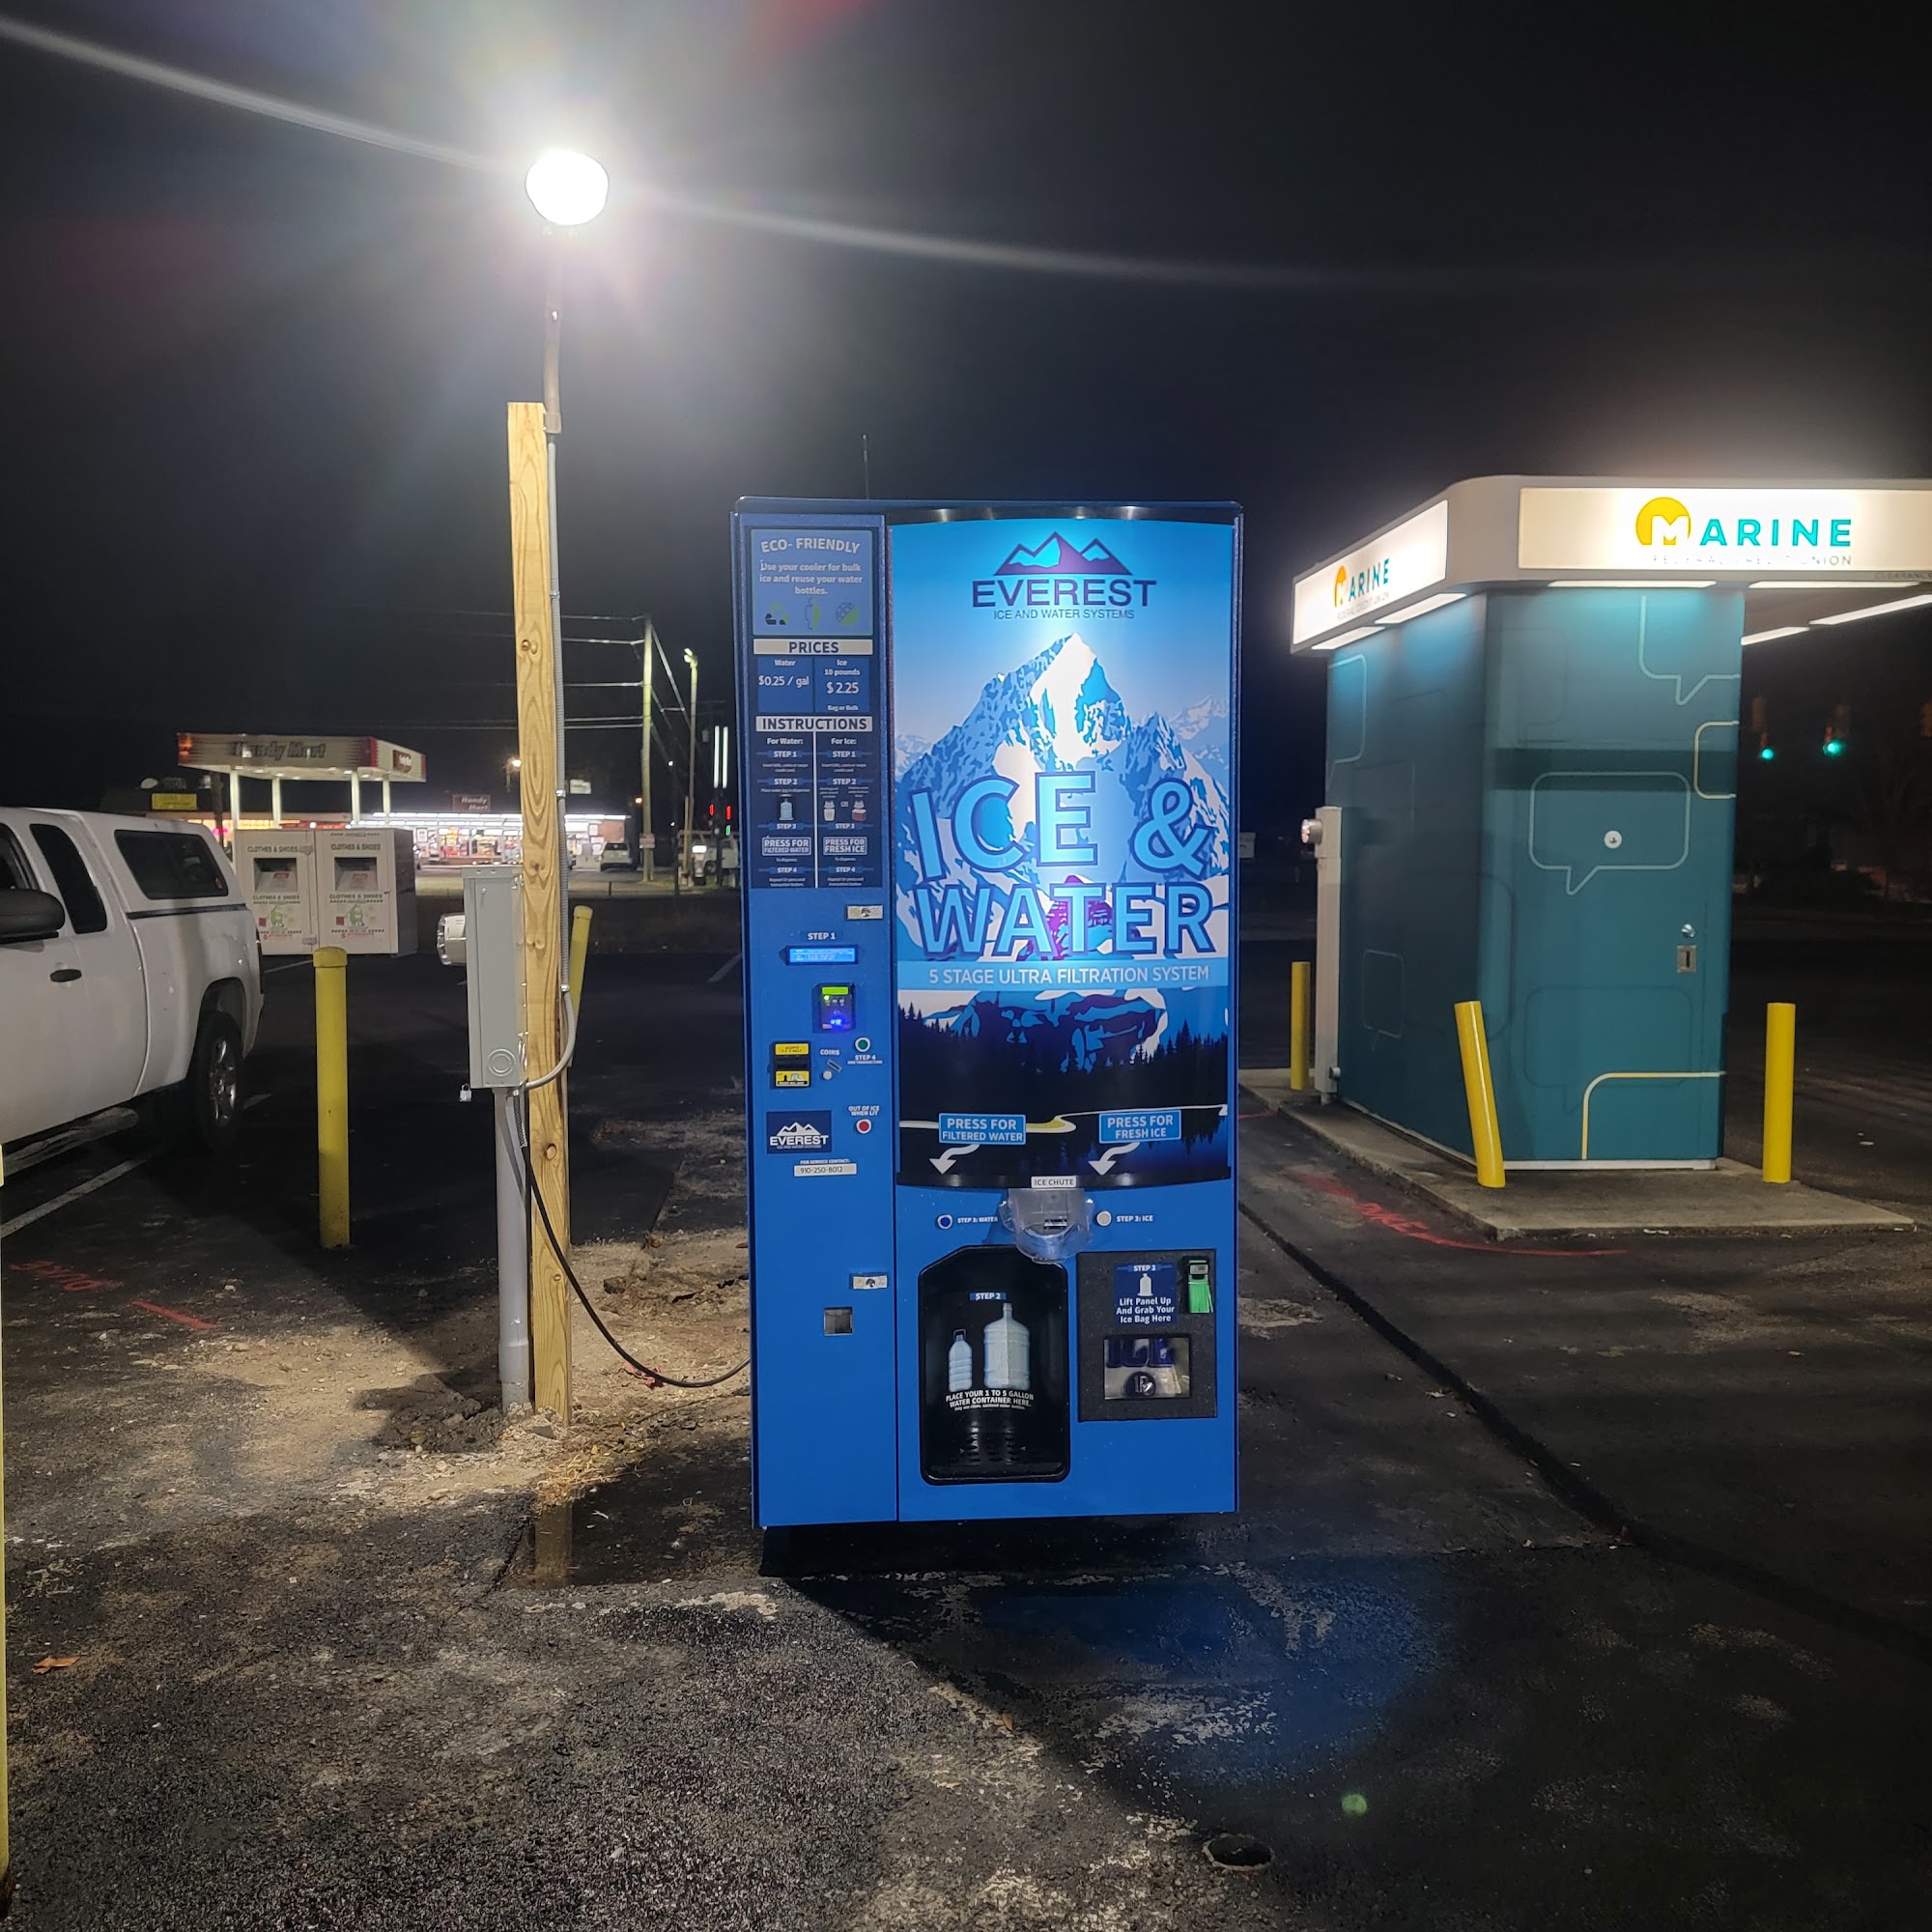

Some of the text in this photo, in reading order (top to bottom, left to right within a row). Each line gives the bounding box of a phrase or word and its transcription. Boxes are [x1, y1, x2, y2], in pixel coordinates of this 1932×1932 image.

[1635, 496, 1853, 547] MARINE
[796, 537, 860, 554] FRIENDLY
[760, 562, 862, 573] Use your cooler for bulk
[759, 575, 772, 583] ice
[773, 575, 789, 583] and
[816, 576, 836, 584] your
[794, 586, 829, 595] bottles.
[972, 579, 1157, 608] EVEREST
[994, 609, 1135, 620] ICE AND WATER SYSTEMS
[788, 641, 839, 654] PRICES
[786, 675, 794, 686] /
[796, 675, 810, 688] gal
[762, 718, 867, 730] INSTRUCTIONS
[909, 771, 1214, 883] ICE &
[915, 882, 1216, 957] WATER
[928, 965, 1209, 983] 5 STAGE ULTRA FILTRATION SYSTEM
[946, 1118, 1017, 1130] PRESS FOR
[1107, 1114, 1174, 1129] PRESS FOR
[942, 1131, 1023, 1142] FILTERED WATER
[1115, 1127, 1167, 1139] FRESH ICE
[769, 1135, 829, 1146] EVEREST
[1048, 1178, 1074, 1186] CHUTE
[1135, 1296, 1158, 1305] Panel
[1160, 1296, 1172, 1306] Up
[1134, 1315, 1151, 1324] Bag
[946, 1392, 963, 1403] PLACE
[1009, 1391, 1034, 1400] GALLON
[950, 1399, 971, 1408] WATER
